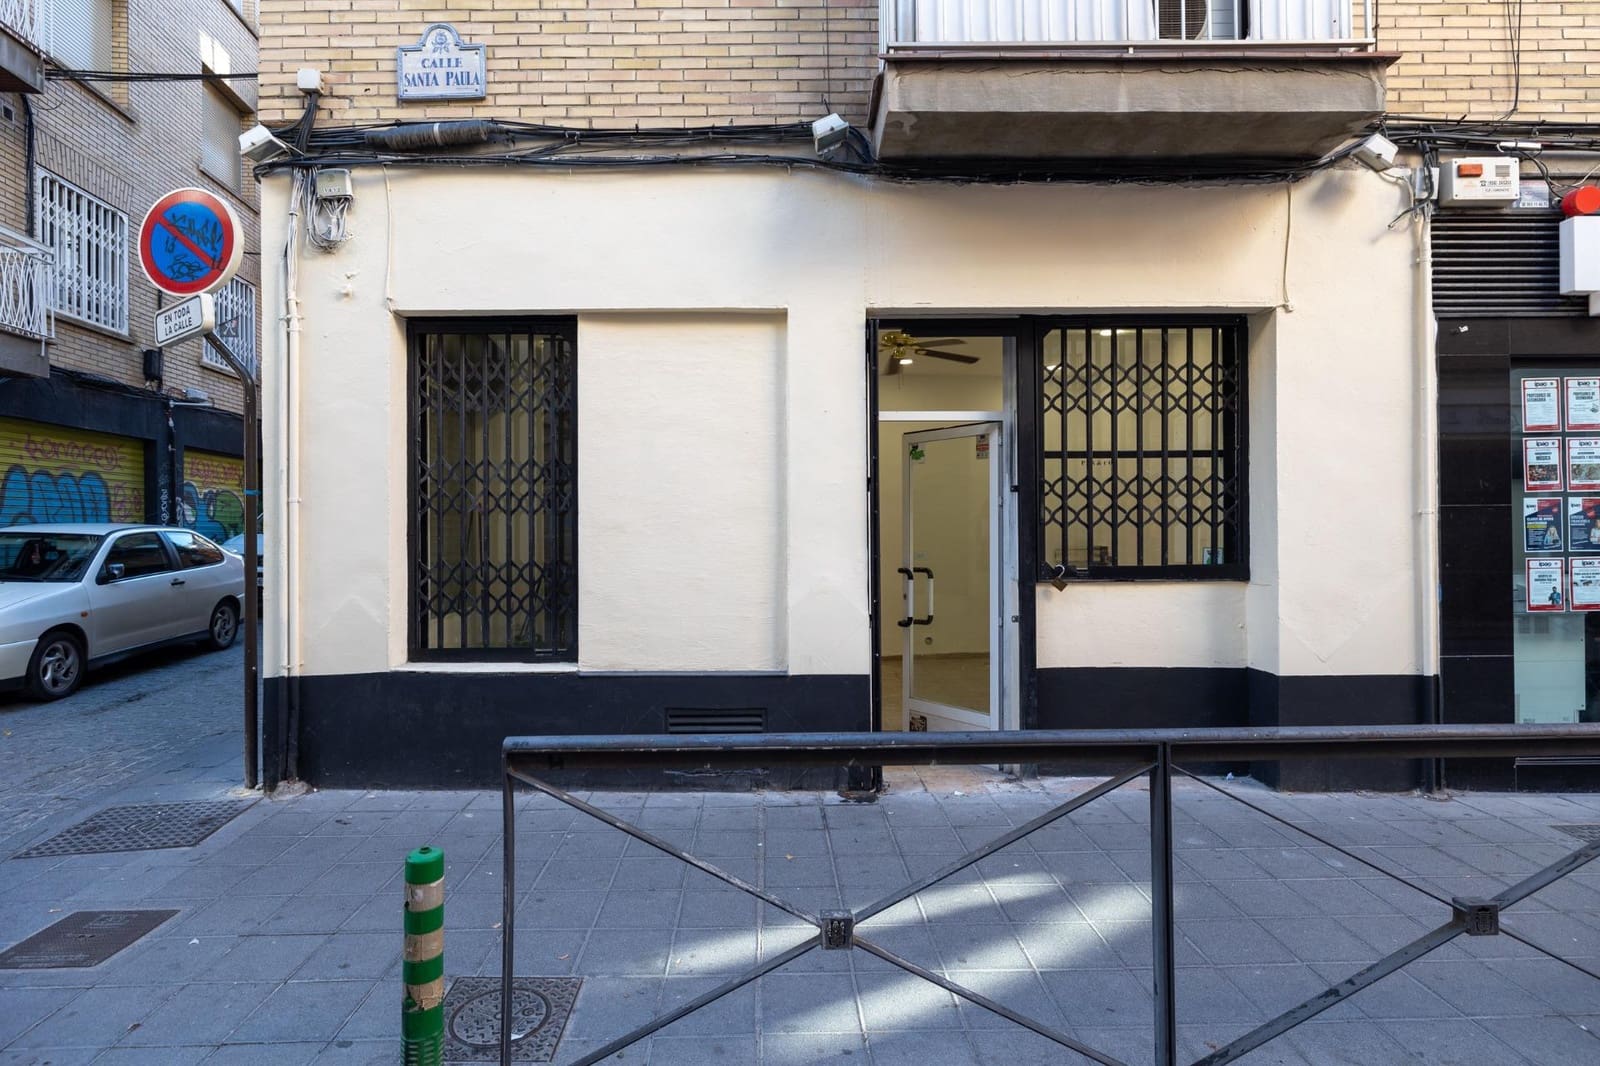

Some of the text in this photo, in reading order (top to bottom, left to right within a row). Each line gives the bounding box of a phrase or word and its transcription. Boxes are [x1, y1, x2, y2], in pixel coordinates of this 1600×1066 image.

[421, 57, 463, 68] CALLE
[404, 71, 480, 87] SANTA PAULA
[164, 305, 190, 324] EN TODA
[165, 316, 192, 336] LA CALLE
